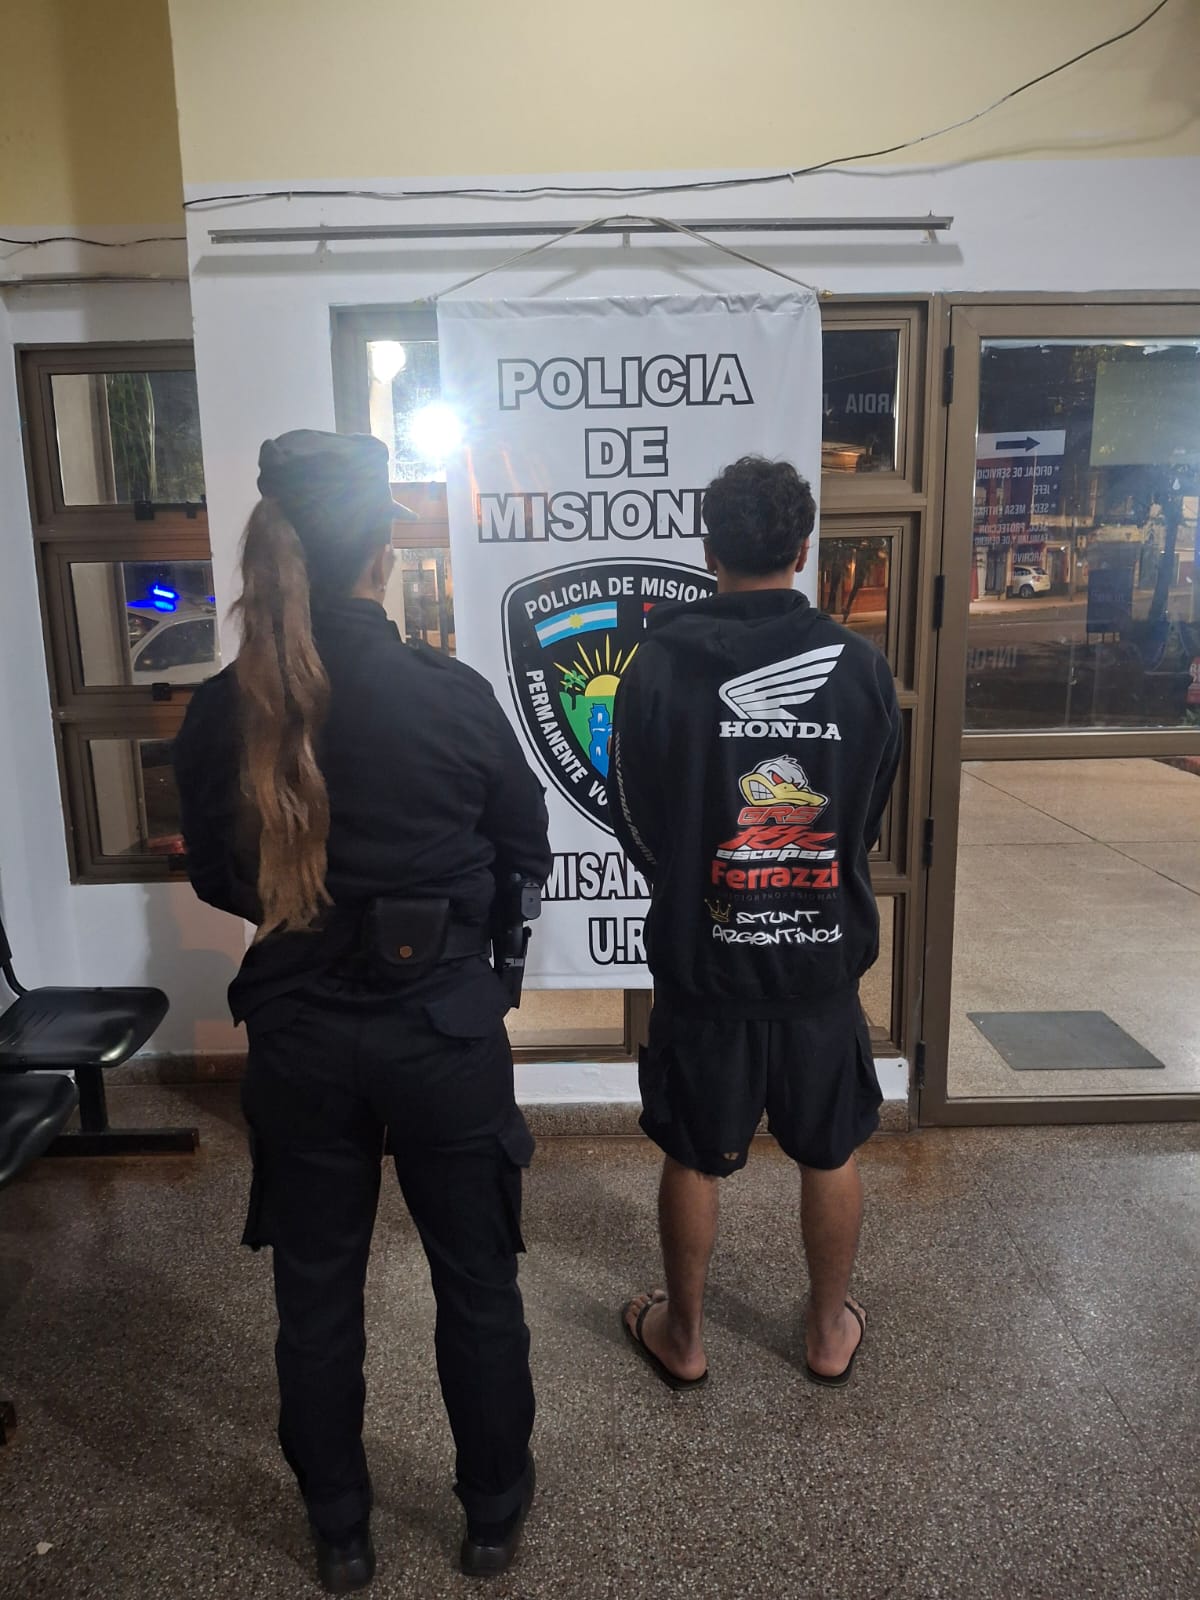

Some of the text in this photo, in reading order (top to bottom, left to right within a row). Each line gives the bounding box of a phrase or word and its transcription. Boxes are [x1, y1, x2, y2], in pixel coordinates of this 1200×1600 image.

[498, 354, 754, 411] POLICIA
[585, 426, 668, 479] DE
[478, 488, 710, 543] MISION
[524, 579, 602, 619] POLICIA
[608, 577, 634, 596] DE
[526, 669, 589, 784] PERMANENTE
[719, 720, 842, 741] HONDA
[711, 860, 840, 890] Ferrazzi
[736, 909, 821, 925] STUNT
